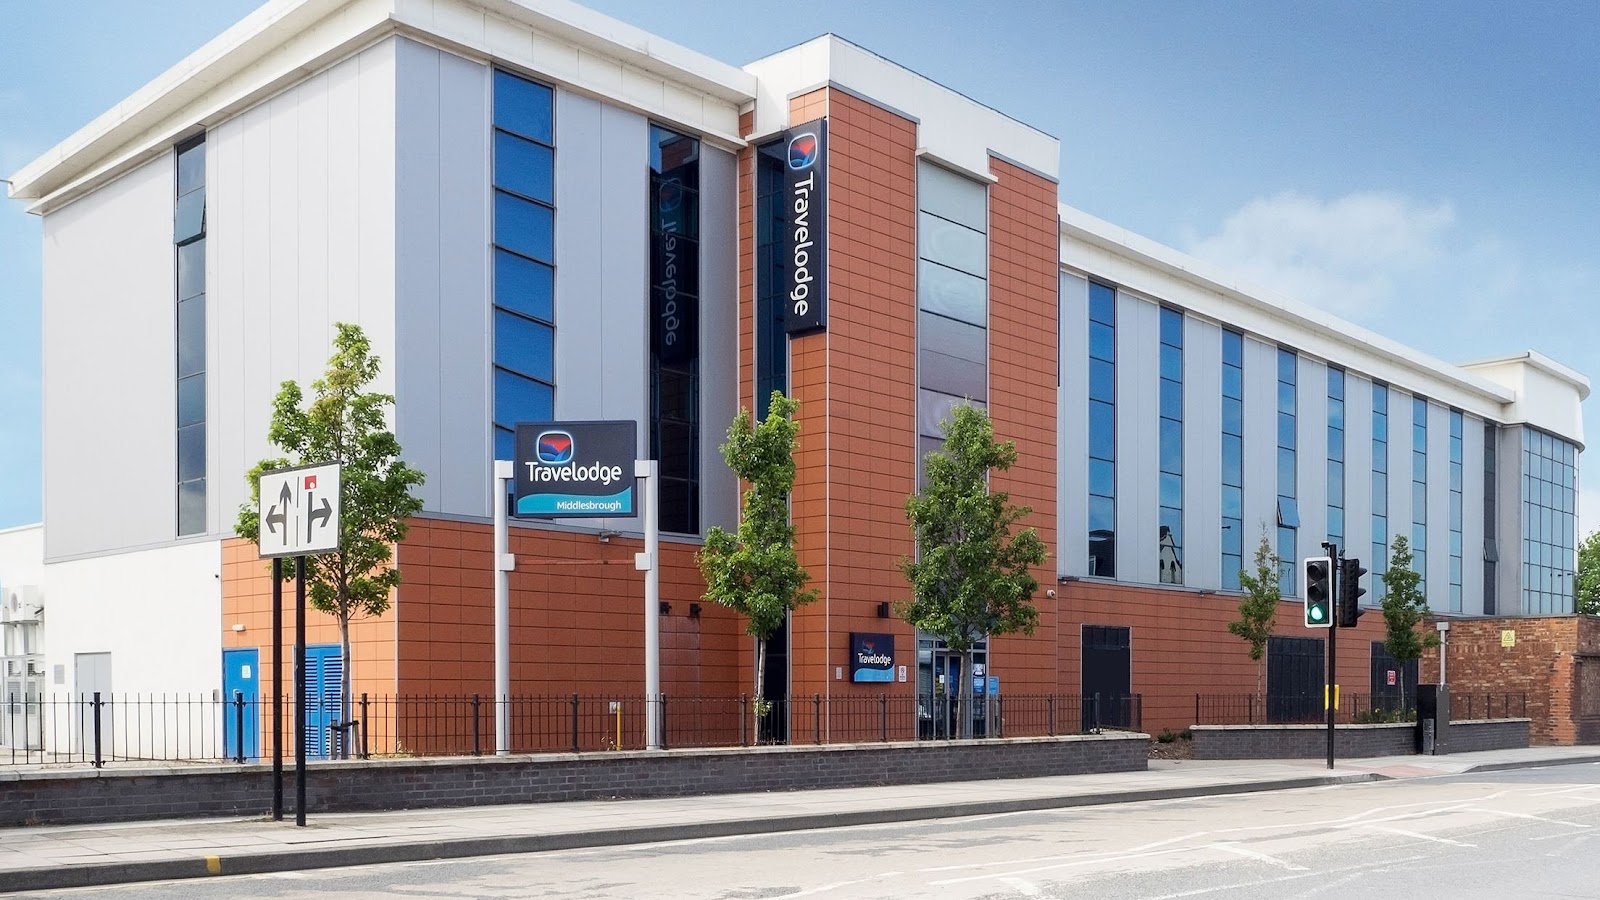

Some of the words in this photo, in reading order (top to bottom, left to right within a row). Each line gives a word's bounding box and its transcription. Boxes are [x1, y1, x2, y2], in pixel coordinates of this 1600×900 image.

[790, 171, 813, 316] Travelodge
[525, 461, 622, 485] Travelodge
[557, 501, 621, 510] Middlesbrough
[858, 653, 892, 666] Travelodge
